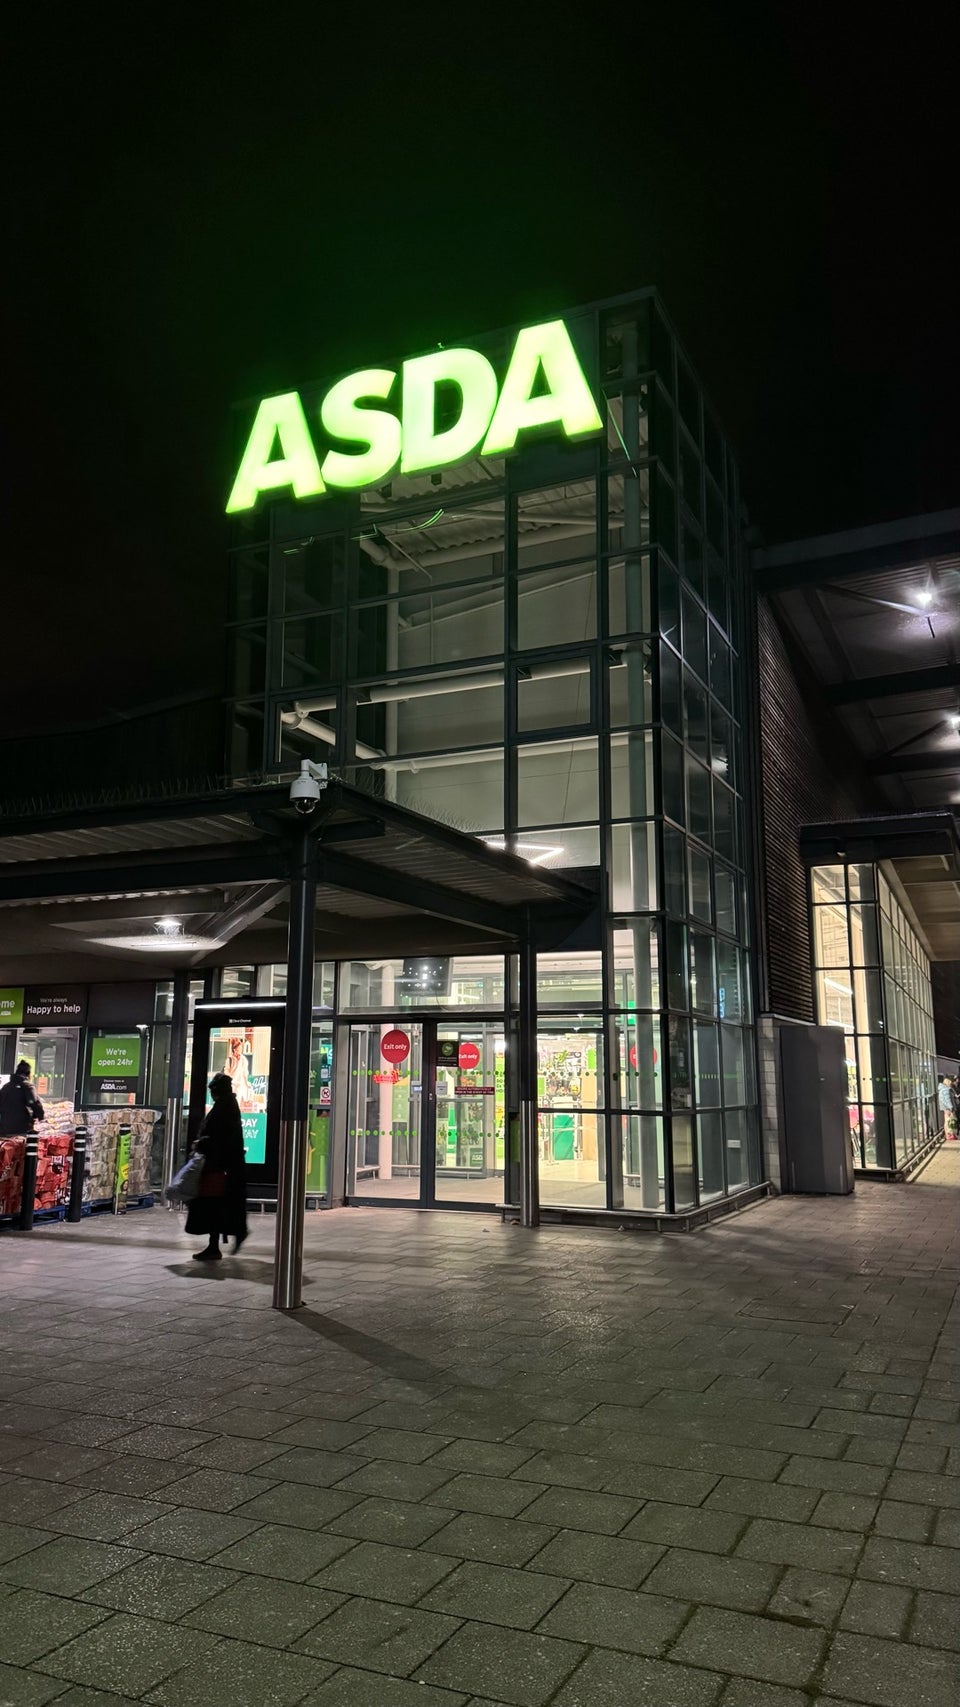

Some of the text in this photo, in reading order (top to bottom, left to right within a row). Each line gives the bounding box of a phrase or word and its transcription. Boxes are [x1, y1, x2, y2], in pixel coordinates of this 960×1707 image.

[226, 319, 604, 513] ASDA
[0, 1000, 15, 1008] me
[27, 1004, 81, 1015] Happy to help
[97, 1058, 133, 1067] open 24hr
